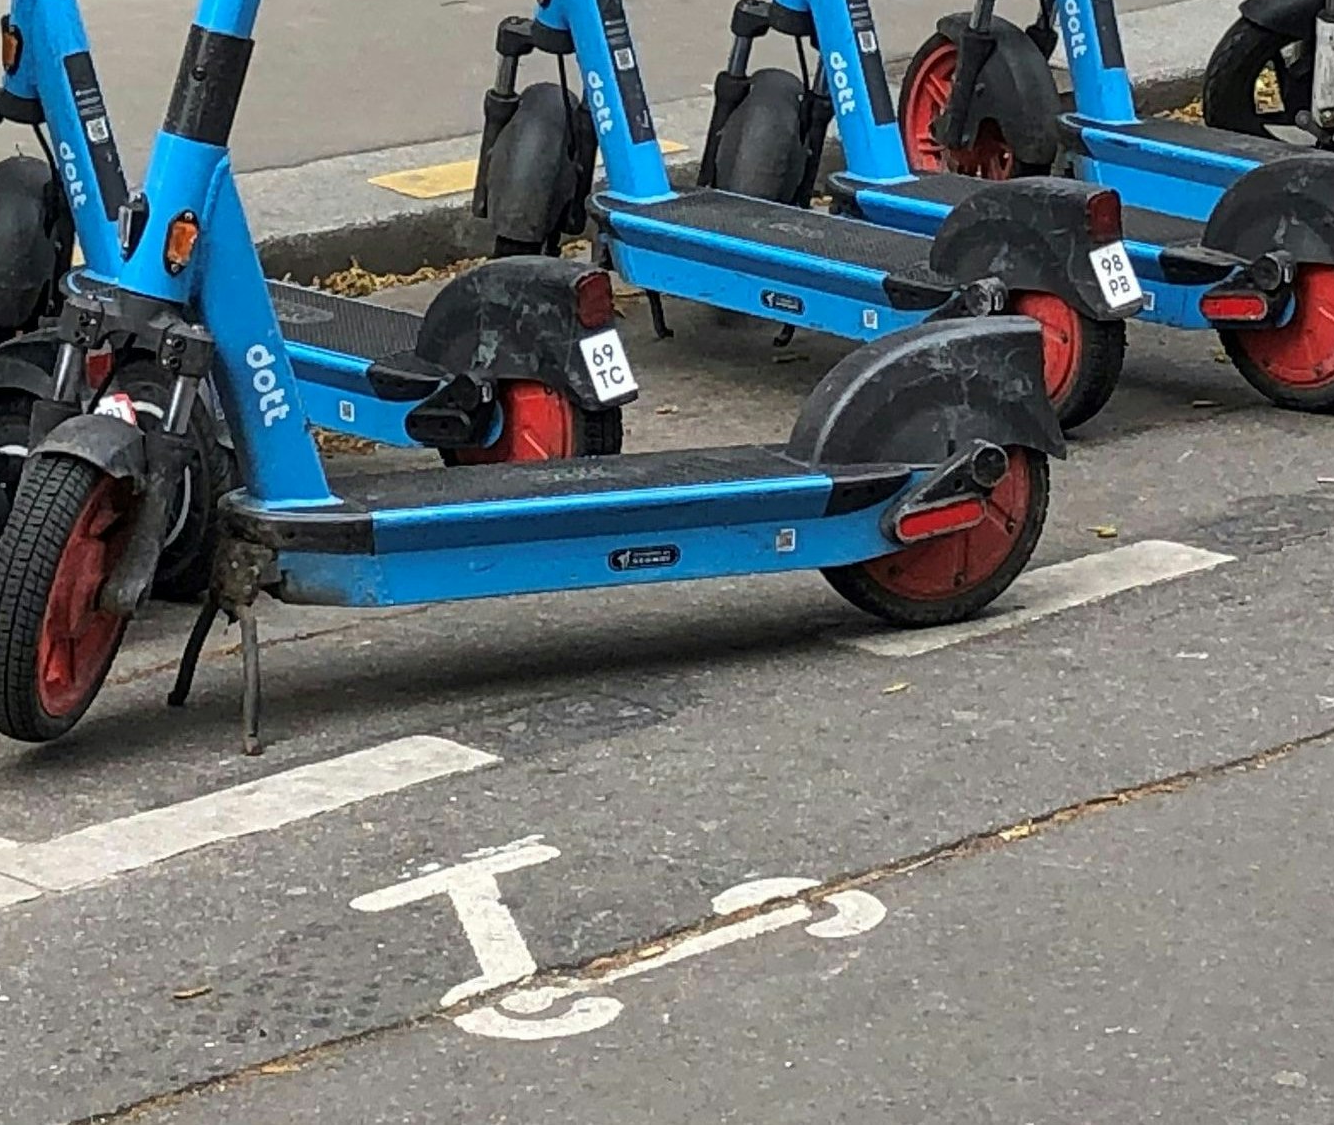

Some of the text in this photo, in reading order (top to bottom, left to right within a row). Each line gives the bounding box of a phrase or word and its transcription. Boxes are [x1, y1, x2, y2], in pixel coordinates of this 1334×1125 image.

[587, 70, 613, 136] dott
[830, 51, 855, 116] dott
[59, 140, 87, 209] dott
[1101, 254, 1123, 276] 98
[1108, 275, 1130, 296] PB
[592, 343, 613, 366] 69
[246, 344, 290, 427] dott
[596, 365, 624, 389] TC
